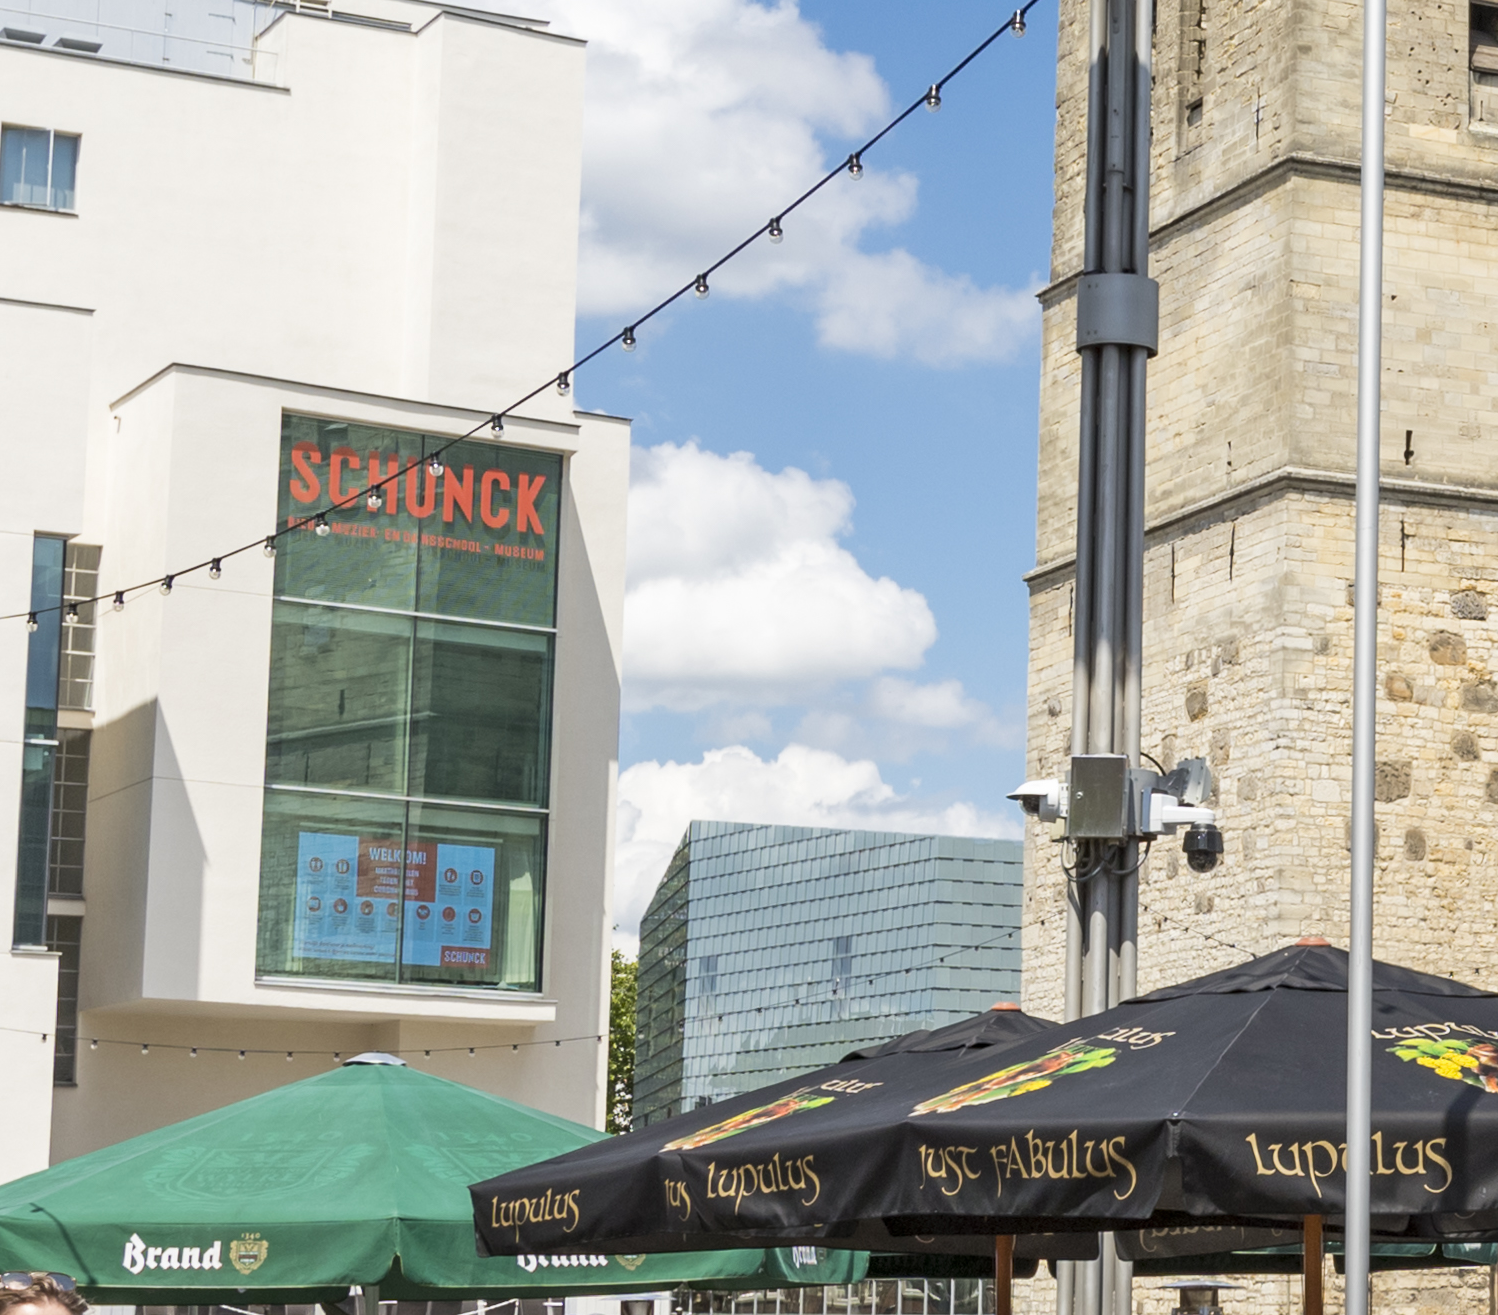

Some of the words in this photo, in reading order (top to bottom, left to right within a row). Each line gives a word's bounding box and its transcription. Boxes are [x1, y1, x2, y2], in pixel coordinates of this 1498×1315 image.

[289, 441, 546, 536] SCHUNCK
[384, 528, 400, 541] EN
[494, 543, 545, 561] MUSEUM
[443, 951, 486, 964] SCHUNCK
[121, 1233, 223, 1276] Brand
